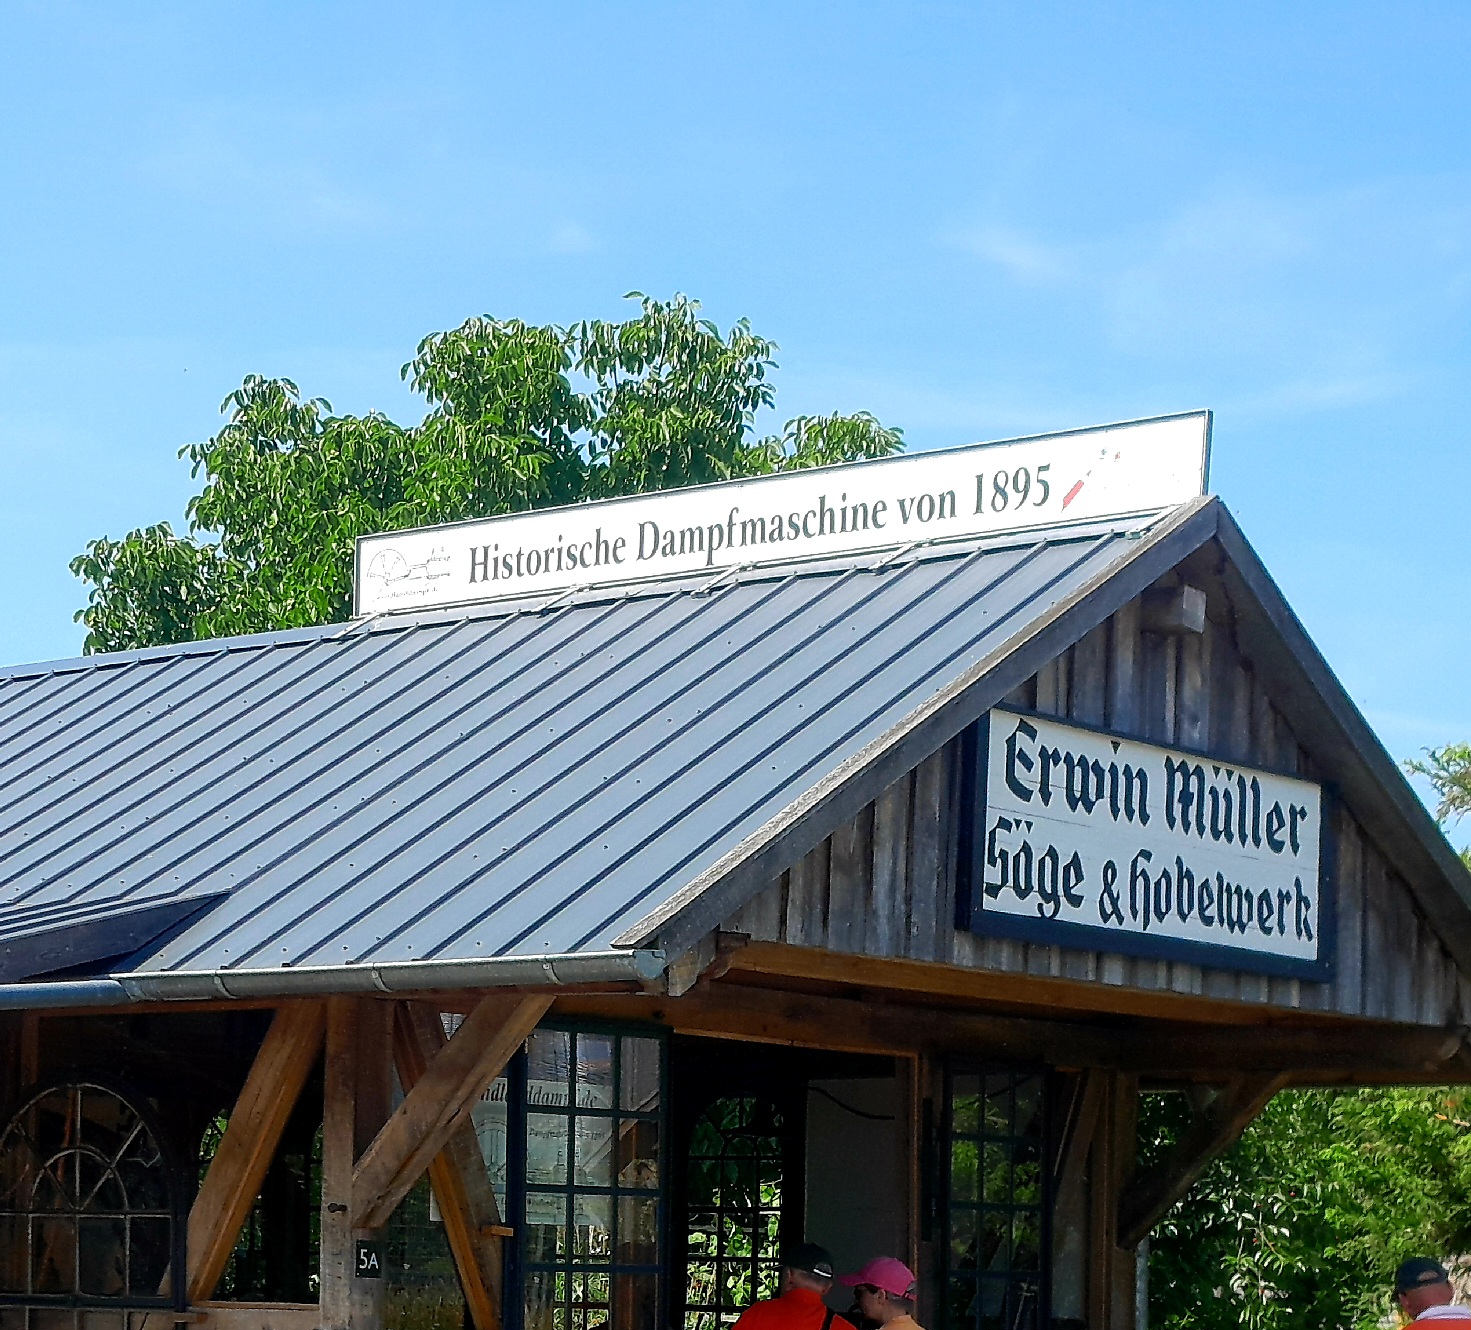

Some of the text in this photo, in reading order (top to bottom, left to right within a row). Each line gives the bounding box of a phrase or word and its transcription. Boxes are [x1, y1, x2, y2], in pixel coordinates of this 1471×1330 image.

[469, 463, 1051, 584] Historische Dampfmaschine von 1895
[1004, 718, 1308, 857] Erwin Müller
[1098, 859, 1125, 926] &
[1130, 848, 1314, 943] Hobelwerk
[359, 1248, 379, 1270] 5A
